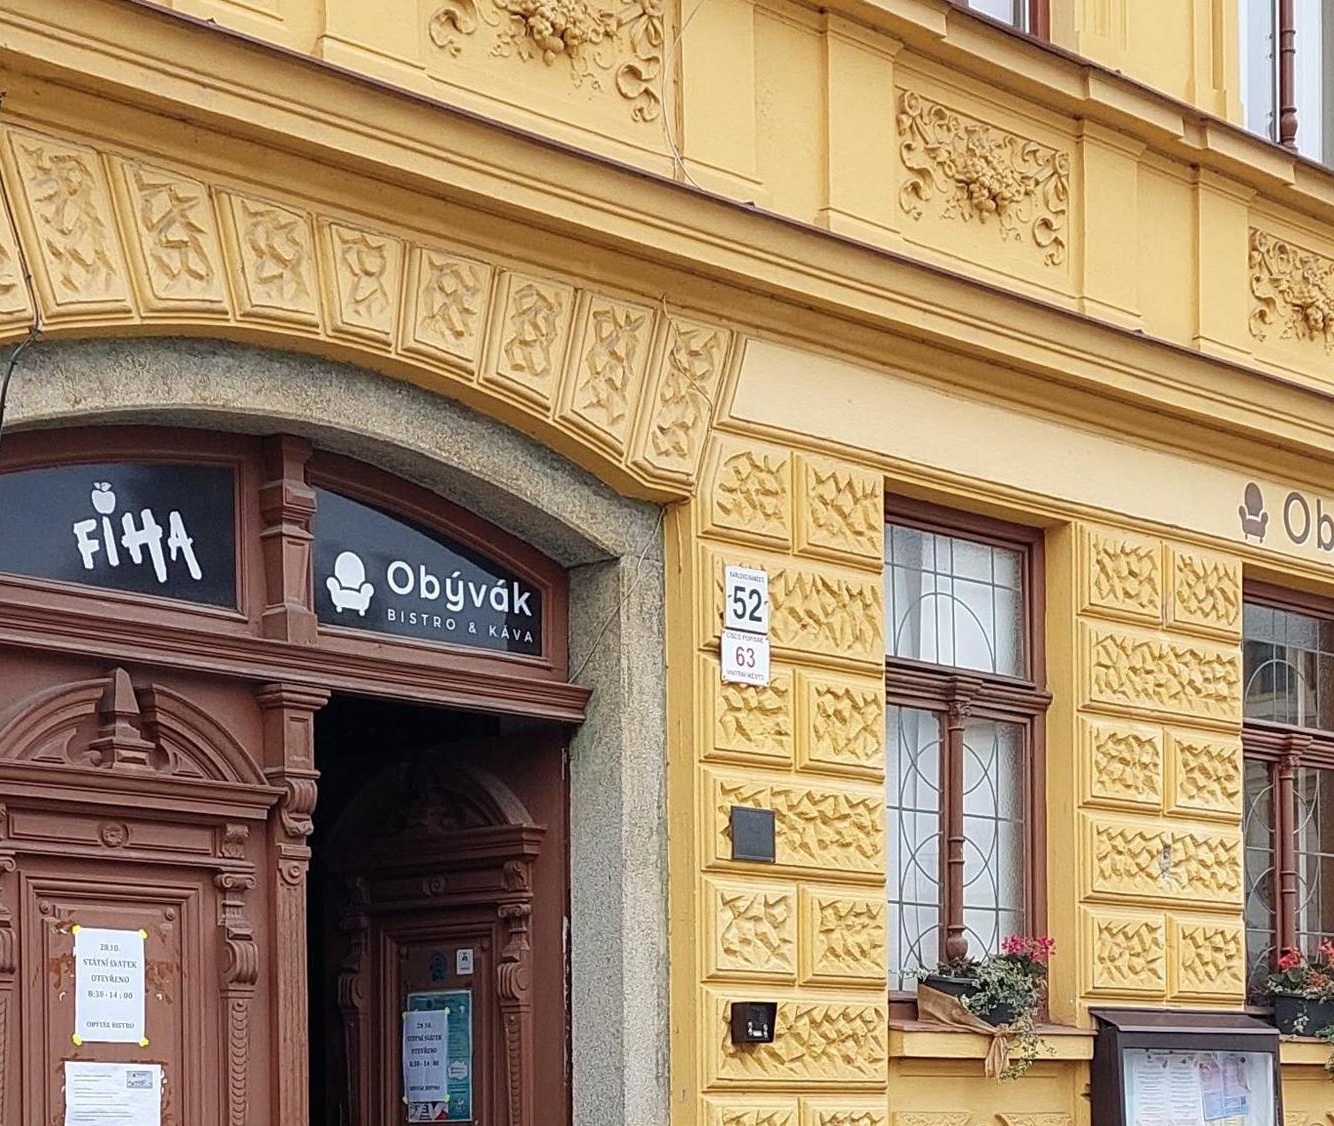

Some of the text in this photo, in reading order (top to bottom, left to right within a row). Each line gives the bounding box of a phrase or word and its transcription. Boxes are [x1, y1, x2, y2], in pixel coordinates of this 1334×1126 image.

[387, 559, 533, 617] Obývák
[732, 585, 763, 623] 52
[387, 608, 534, 644] BISTRO & KÁVA
[735, 645, 756, 669] 63
[91, 974, 130, 984] OTEVŘENO
